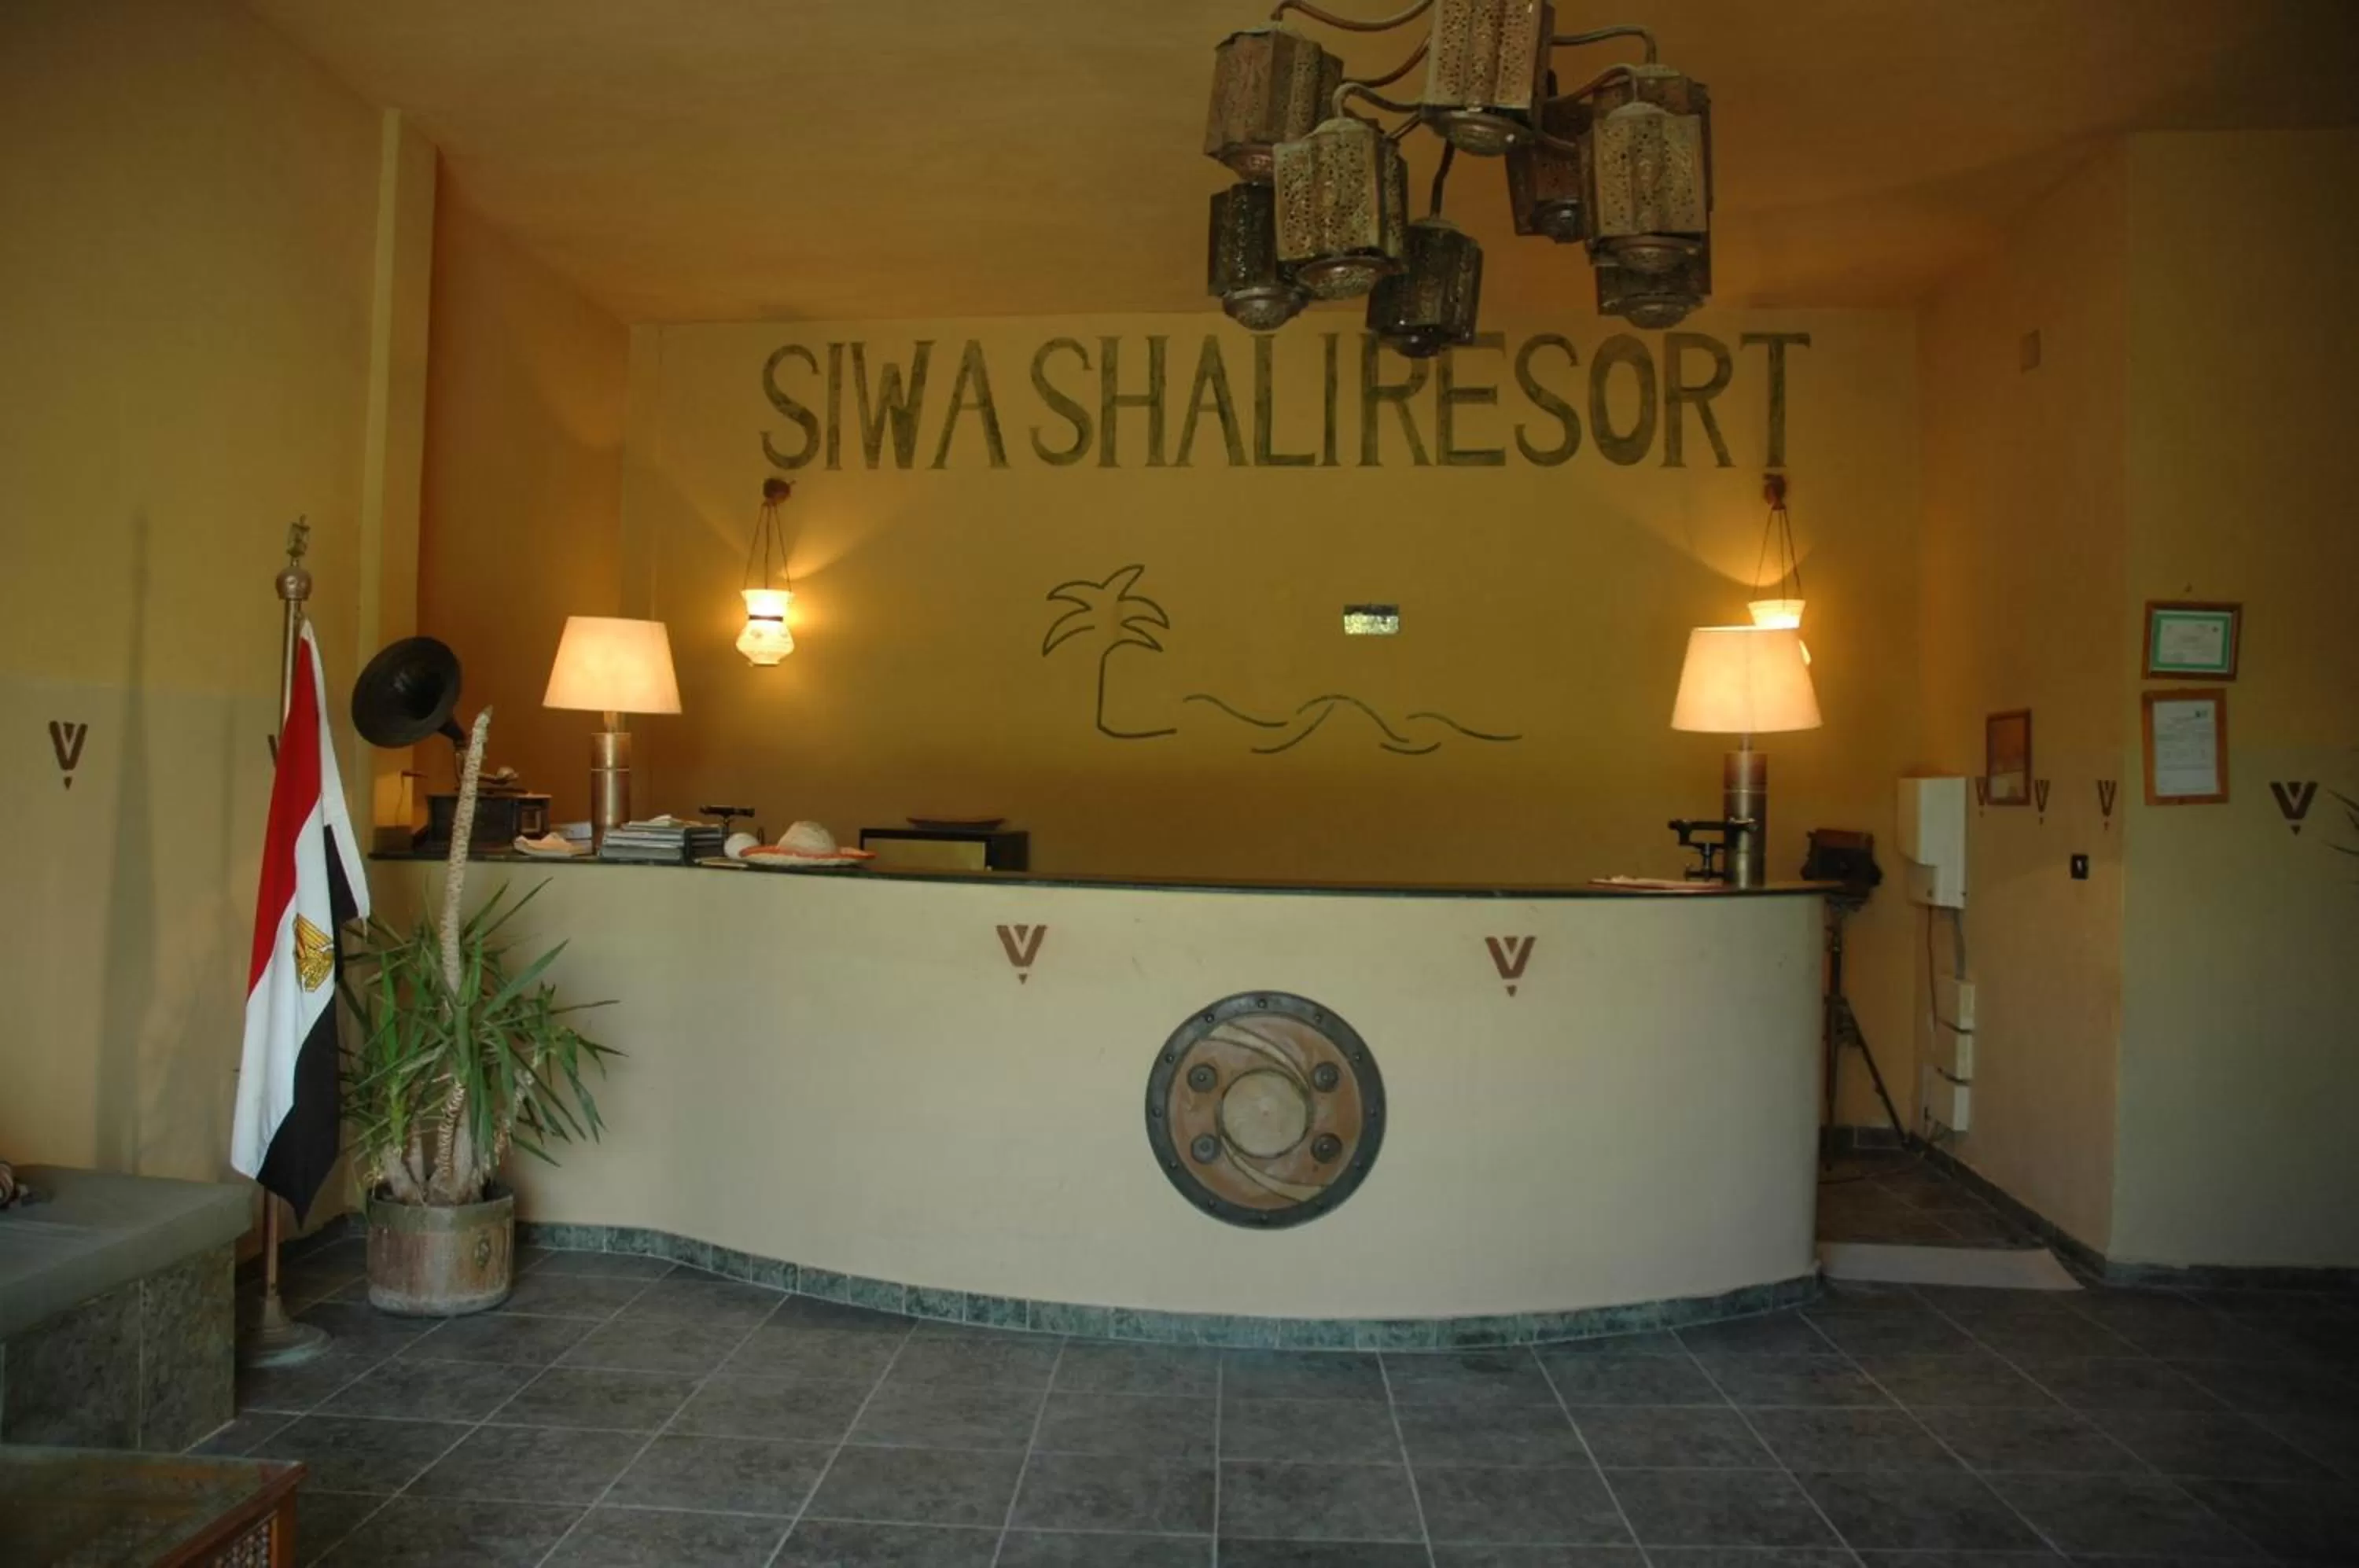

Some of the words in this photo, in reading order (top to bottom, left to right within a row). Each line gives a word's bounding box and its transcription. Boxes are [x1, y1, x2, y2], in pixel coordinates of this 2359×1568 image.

[760, 339, 1011, 470] SIWA
[1029, 333, 1341, 469] SHALI
[1356, 332, 1812, 469] RESORT
